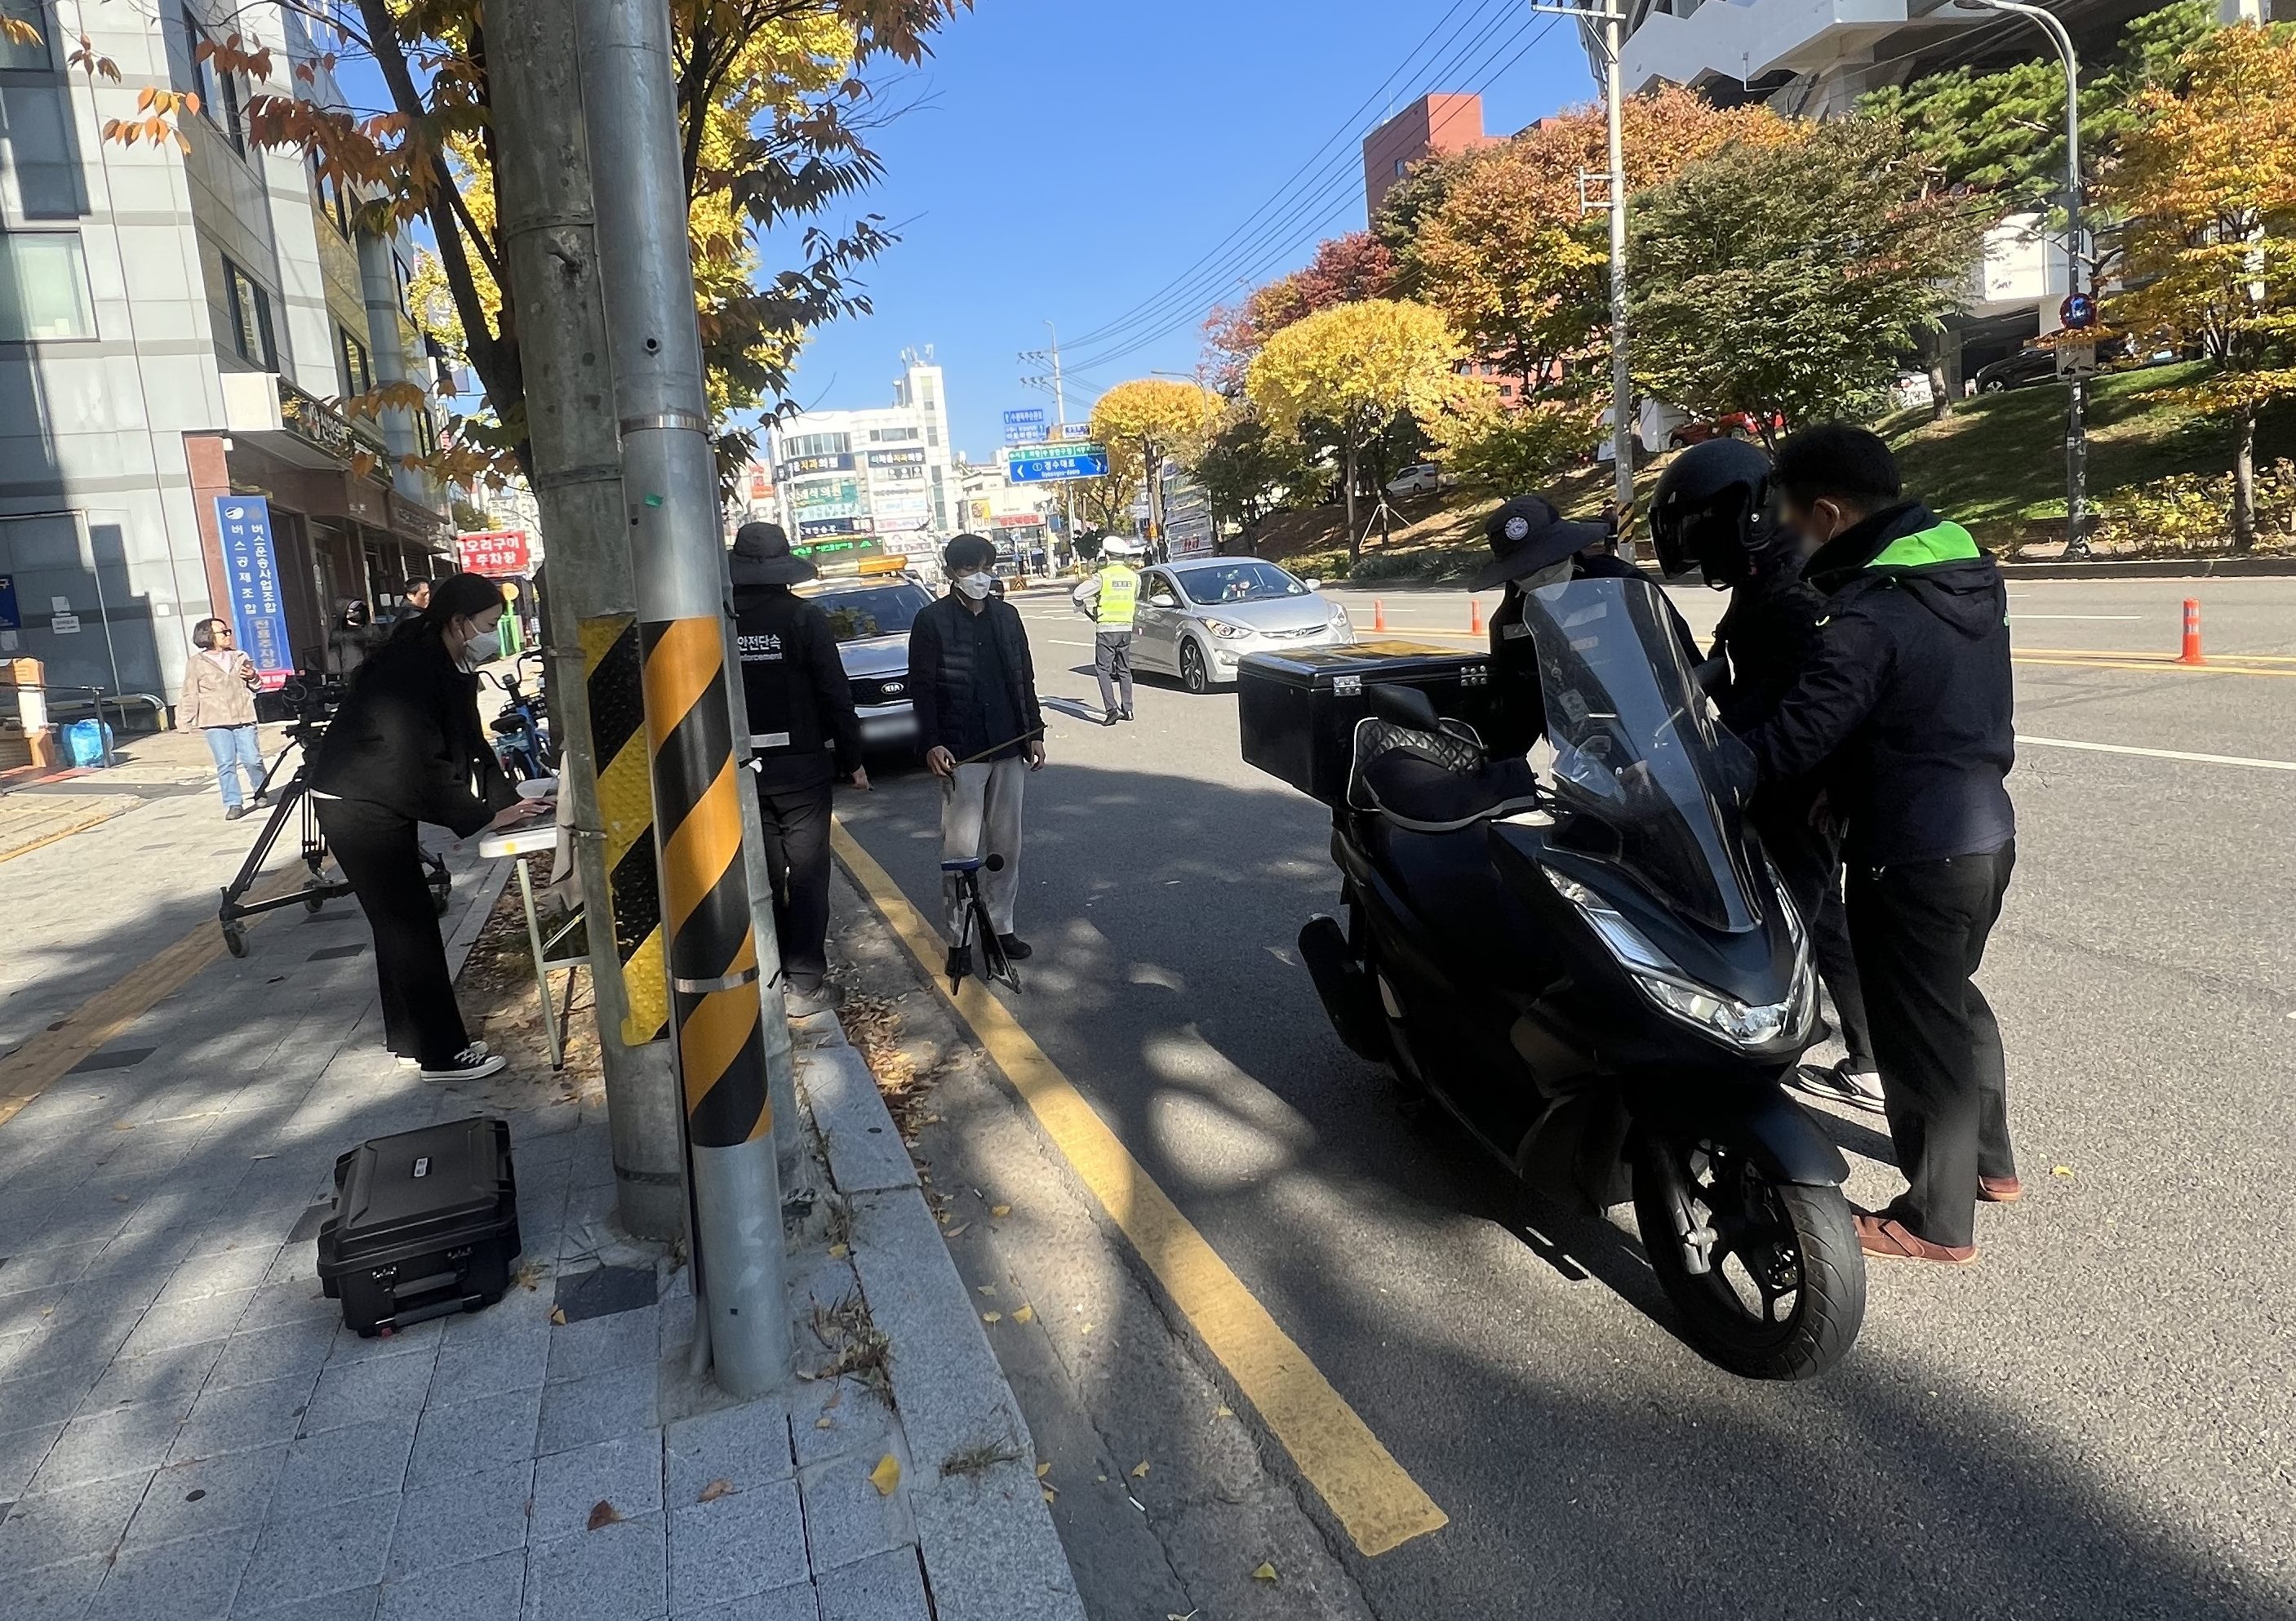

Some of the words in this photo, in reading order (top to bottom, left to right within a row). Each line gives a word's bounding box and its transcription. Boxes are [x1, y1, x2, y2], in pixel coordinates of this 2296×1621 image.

[1044, 459, 1076, 471] 경수대로
[476, 551, 517, 566] 주차장
[231, 524, 258, 615] 버스공제조합
[251, 524, 278, 614] 버스운송사업조합
[737, 633, 781, 651] 안전단속
